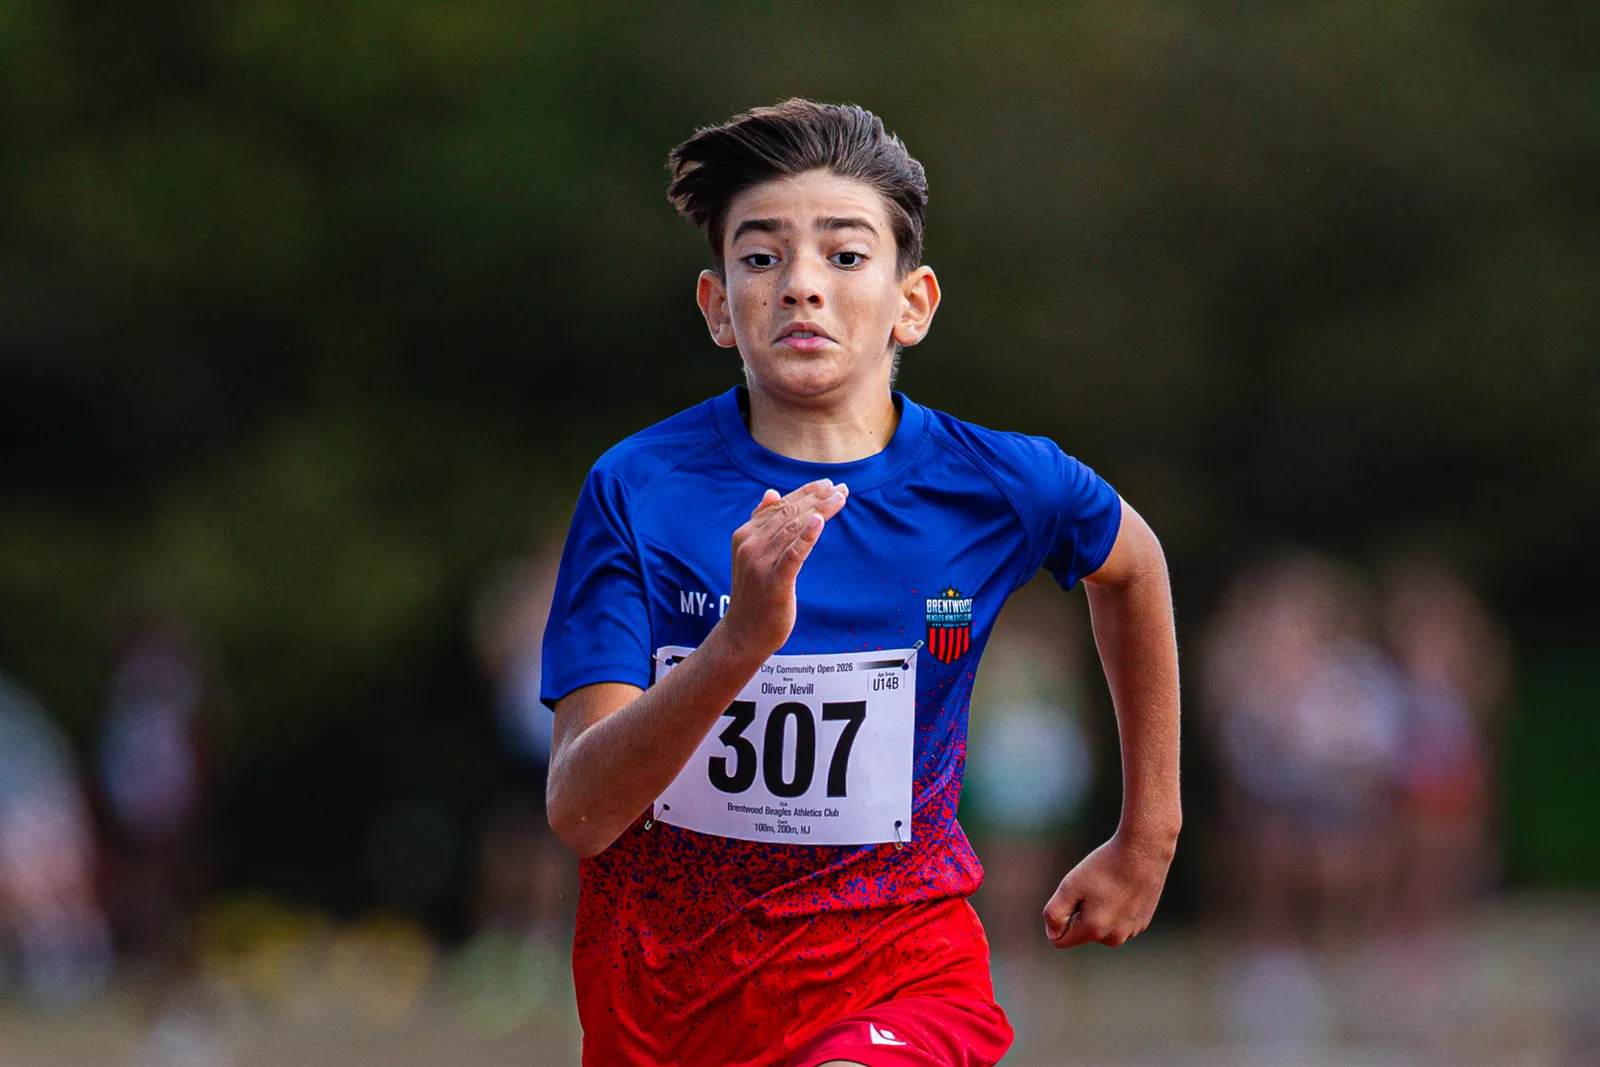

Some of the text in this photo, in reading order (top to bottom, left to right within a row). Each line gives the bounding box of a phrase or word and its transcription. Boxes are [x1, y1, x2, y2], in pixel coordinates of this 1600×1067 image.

[761, 662, 854, 675] City Community Open 2026
[761, 682, 815, 695] Oliver Nevill
[873, 676, 899, 691] U14B
[708, 699, 867, 798] 307
[727, 802, 840, 818] Brentwood Beagles Athletics Club
[754, 823, 811, 835] 100m, 200m, HJ
